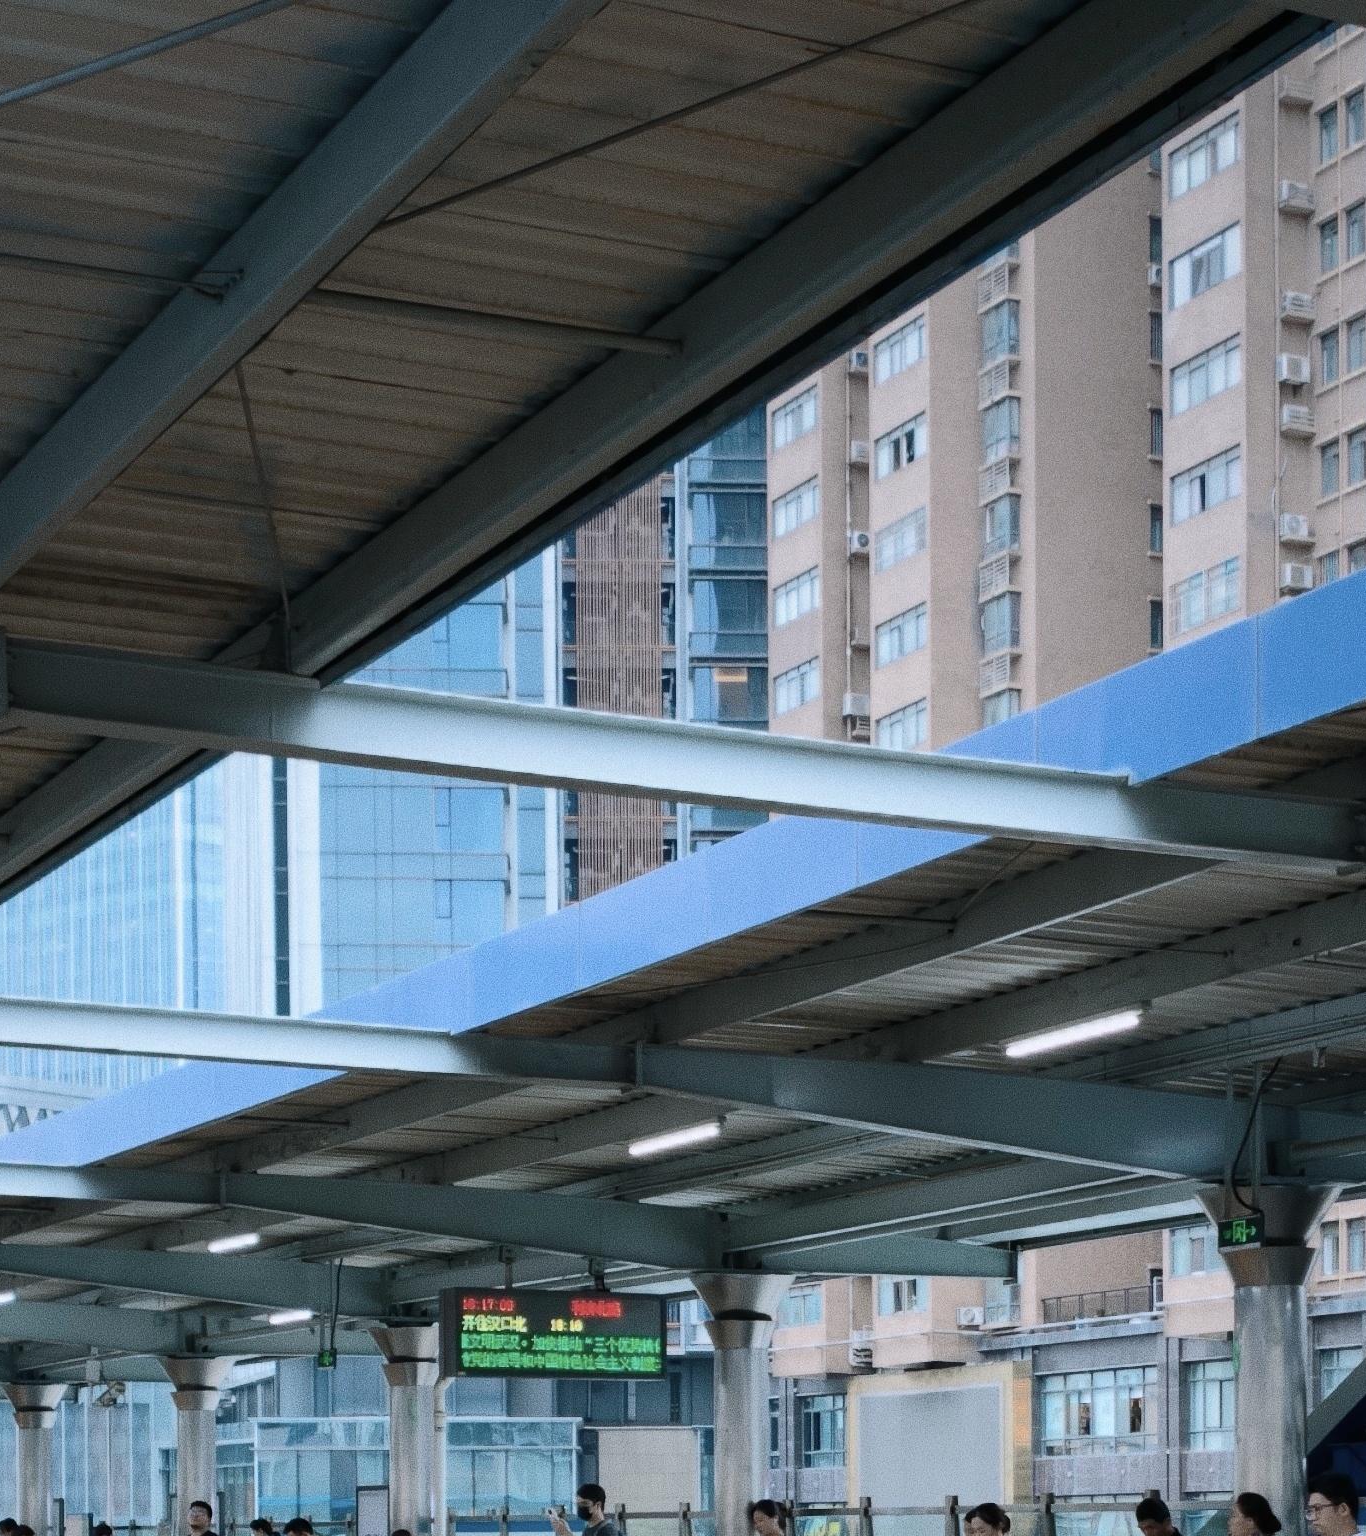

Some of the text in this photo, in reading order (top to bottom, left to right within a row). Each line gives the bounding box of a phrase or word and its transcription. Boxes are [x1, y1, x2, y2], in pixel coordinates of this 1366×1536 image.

[462, 1314, 528, 1332] 开往汉口北
